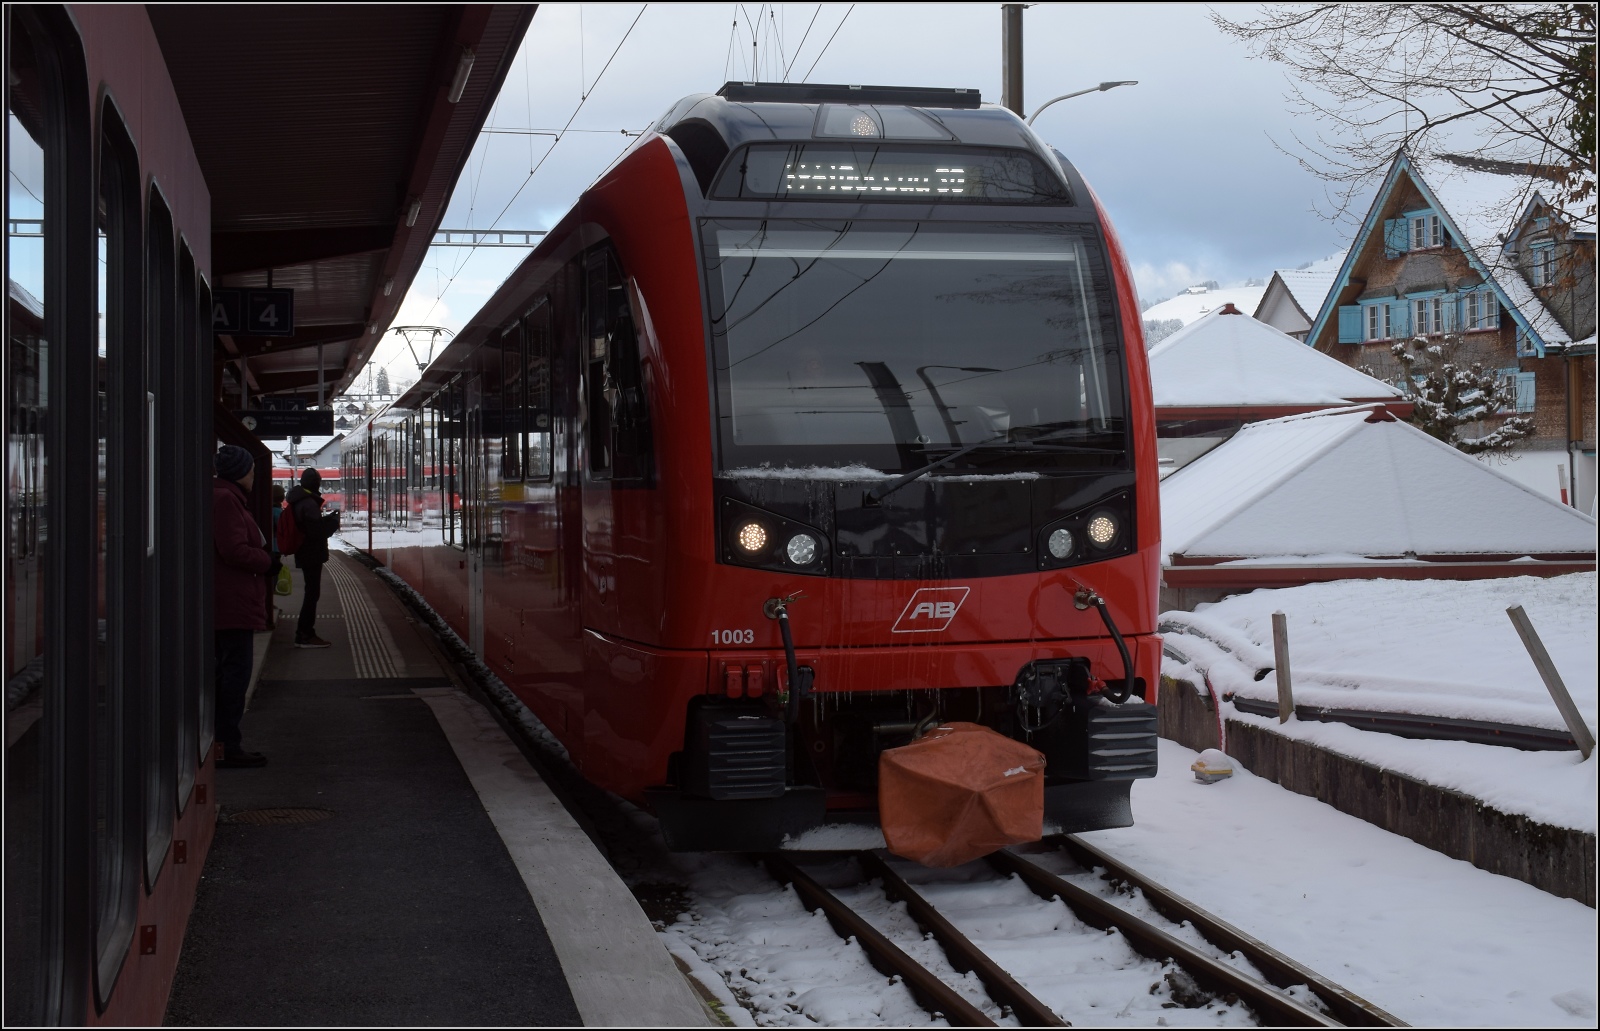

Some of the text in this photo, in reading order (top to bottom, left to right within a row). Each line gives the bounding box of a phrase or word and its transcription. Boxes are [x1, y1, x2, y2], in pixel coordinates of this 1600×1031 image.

[212, 303, 279, 327] A 4
[909, 601, 956, 620] AB
[711, 629, 755, 645] 1003
